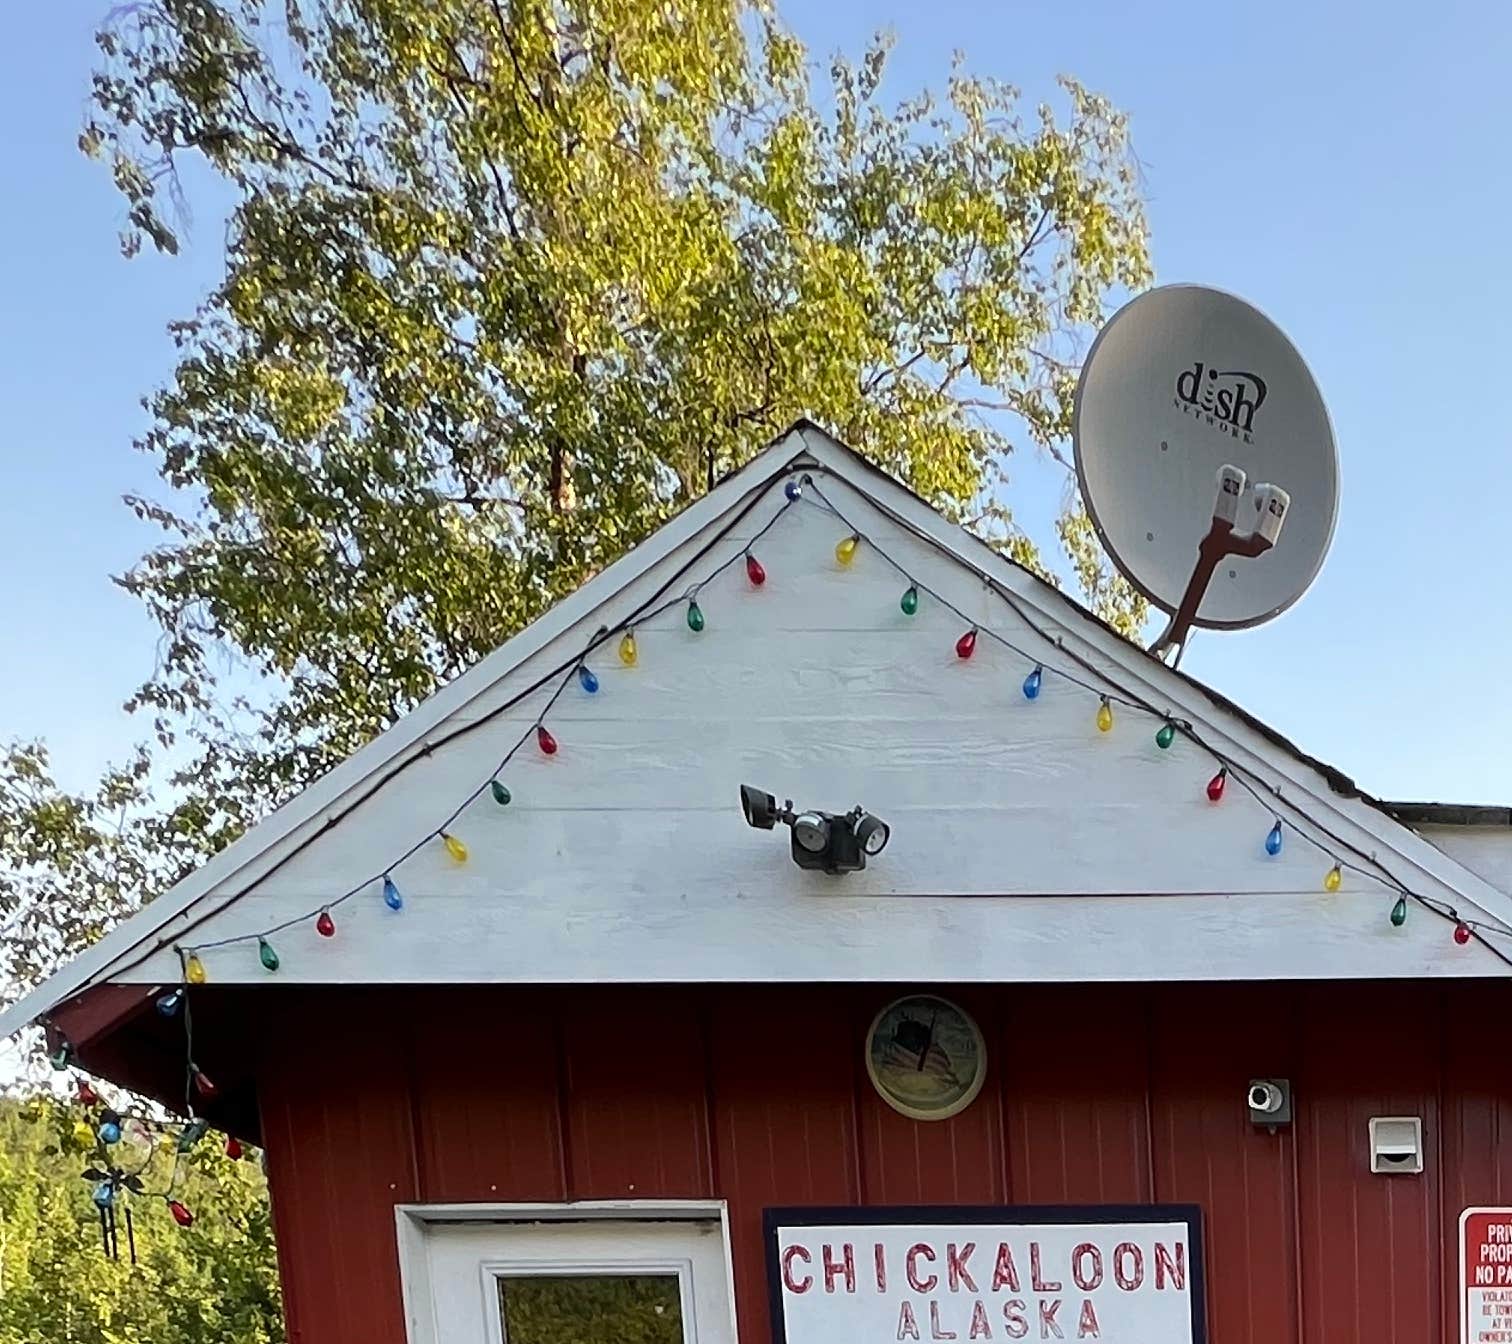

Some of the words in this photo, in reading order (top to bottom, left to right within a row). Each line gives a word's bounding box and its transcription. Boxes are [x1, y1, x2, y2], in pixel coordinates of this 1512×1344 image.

[1177, 362, 1266, 432] dish
[1173, 398, 1254, 444] NETWORK
[781, 1241, 1187, 1294] CHICKALOON
[1475, 1265, 1494, 1284] NO
[896, 1299, 1101, 1340] ALASKA
[1482, 1304, 1492, 1316] BE
[1492, 1318, 1501, 1329] AT
